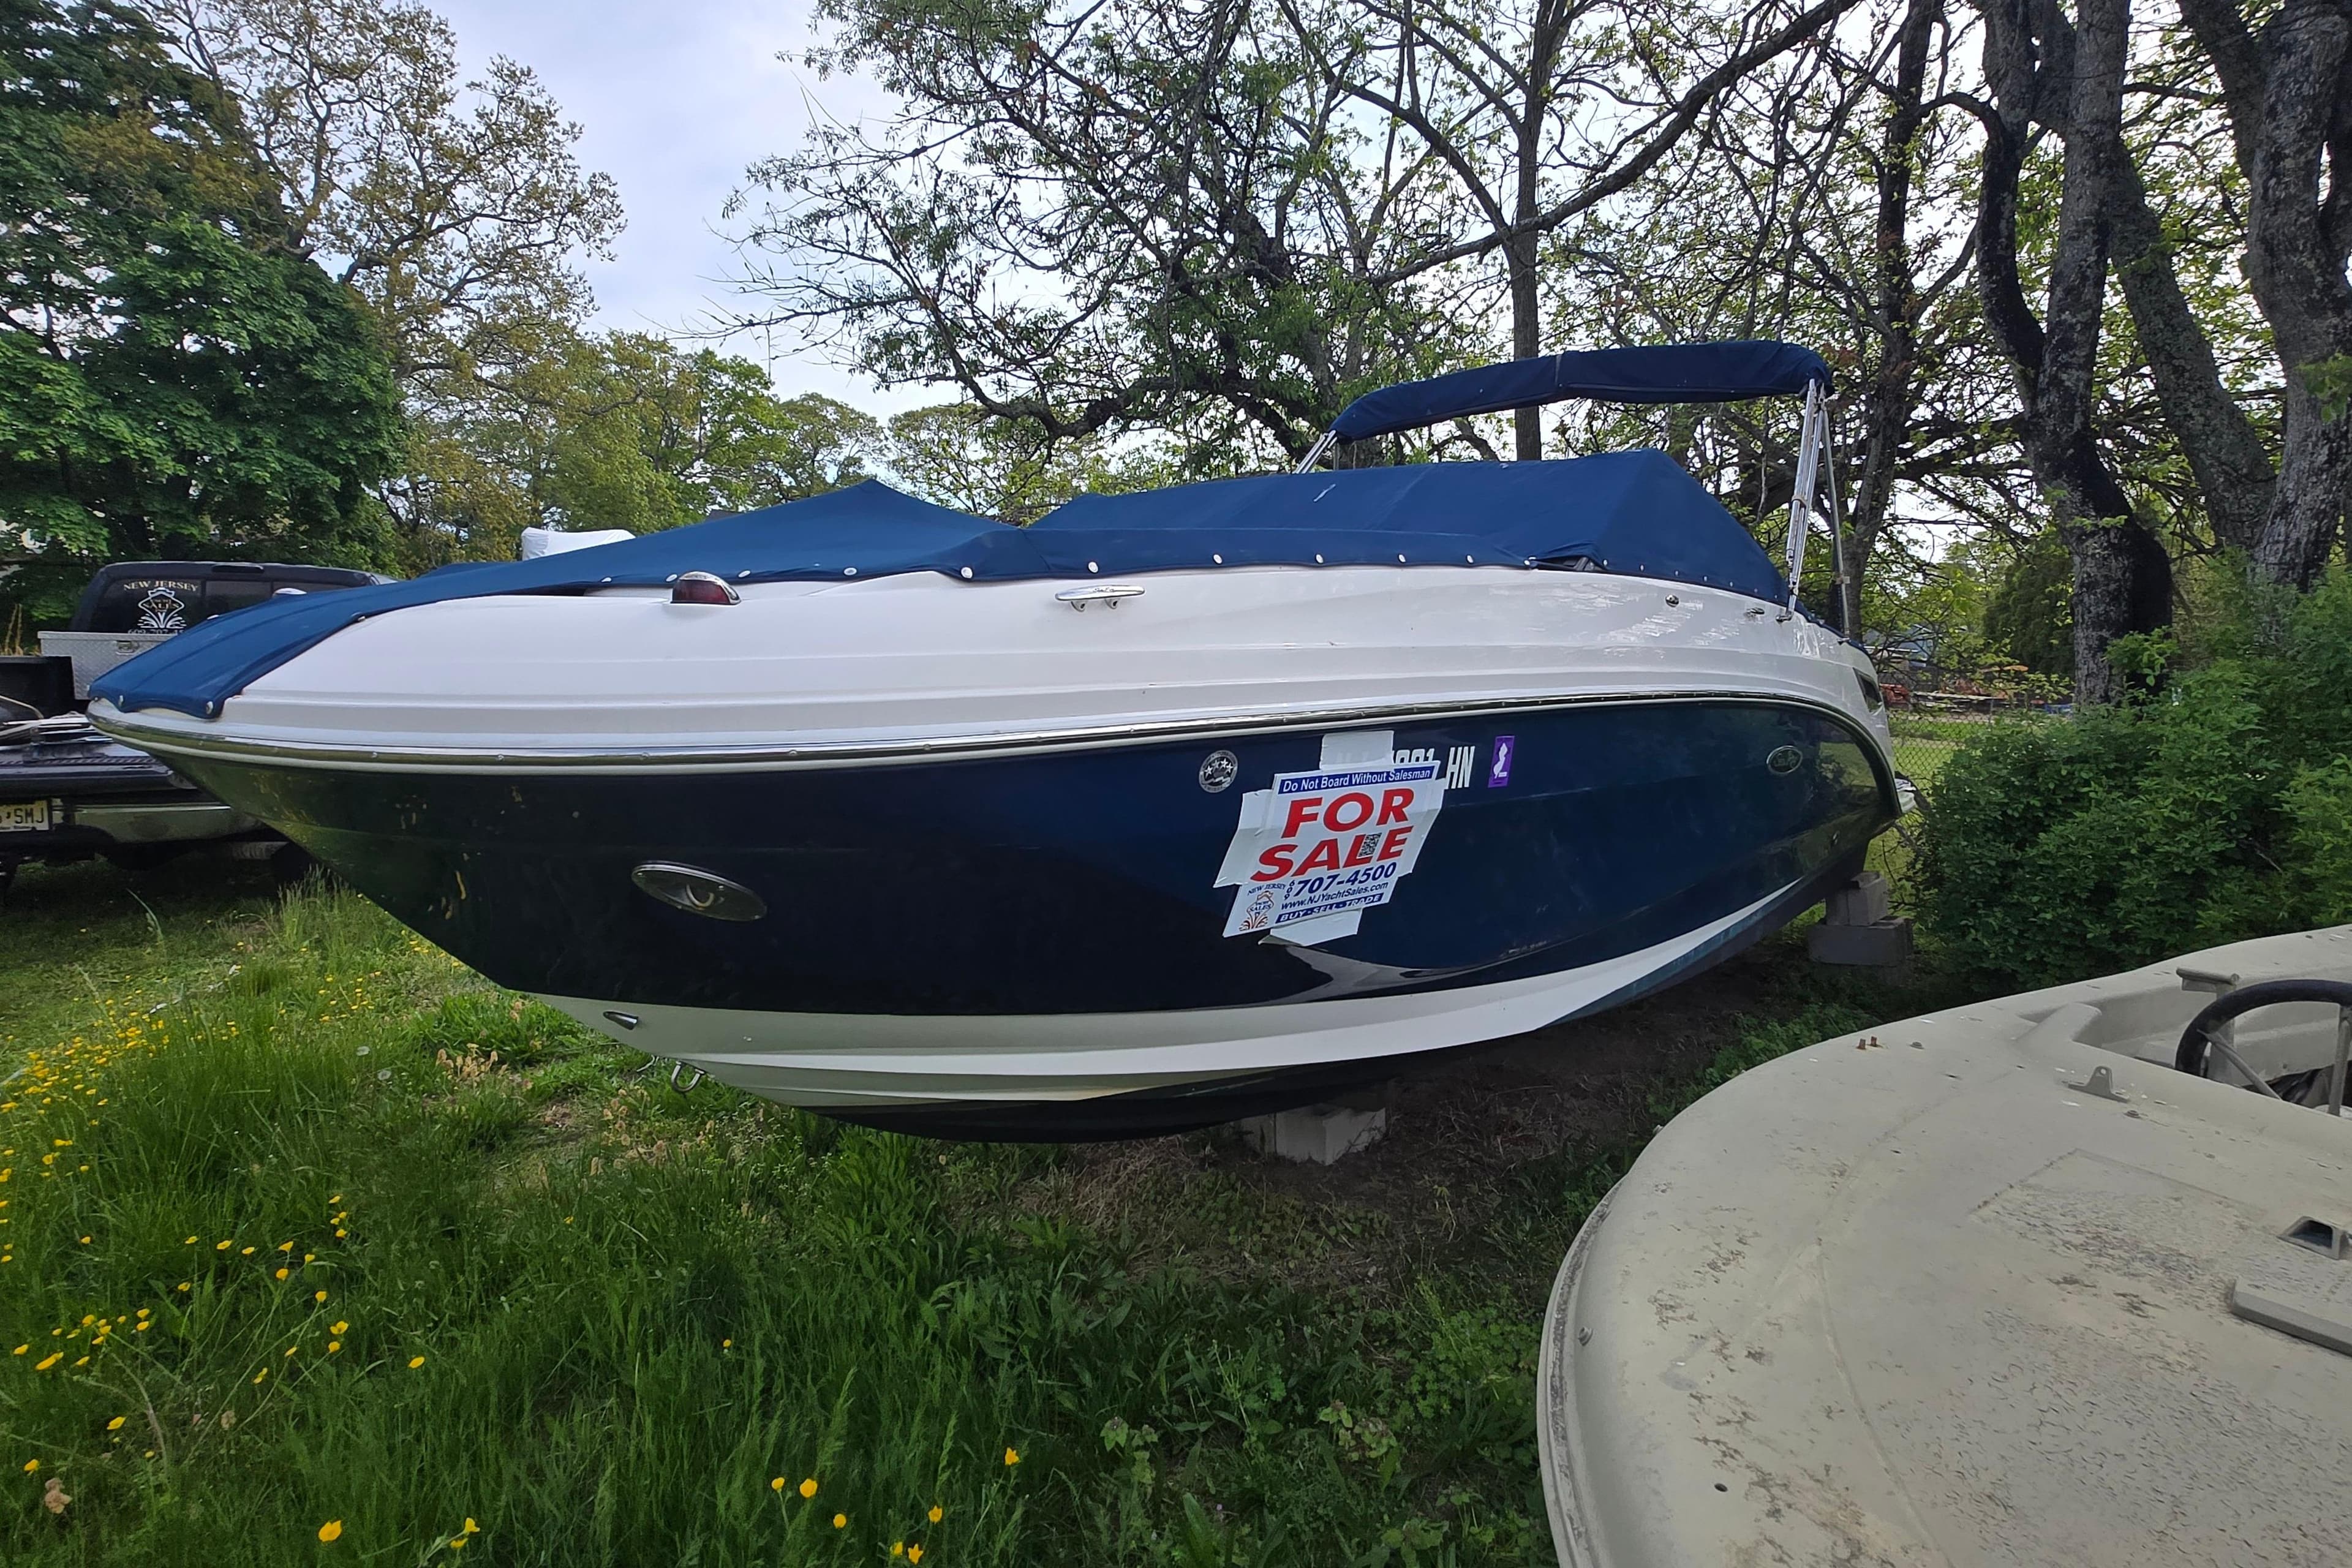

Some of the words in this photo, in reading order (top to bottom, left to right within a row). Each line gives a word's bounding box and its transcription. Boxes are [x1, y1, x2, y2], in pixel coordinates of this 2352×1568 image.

[124, 581, 151, 591] NEW
[154, 580, 198, 592] JERSEY
[1446, 745, 1475, 789] HN
[1283, 780, 1298, 793] Do
[1300, 778, 1320, 790] Not
[1321, 774, 1348, 788] Board
[1351, 772, 1387, 785] Without
[1388, 769, 1430, 781] Salesman
[1281, 788, 1414, 839] FOR
[1250, 826, 1414, 882] SALE
[1247, 884, 1264, 896] NEW
[1284, 880, 1295, 900] 609
[1294, 861, 1397, 897] 707-4500
[1281, 882, 1389, 910] www.NJYachtSales.com
[1280, 910, 1306, 922] BUY
